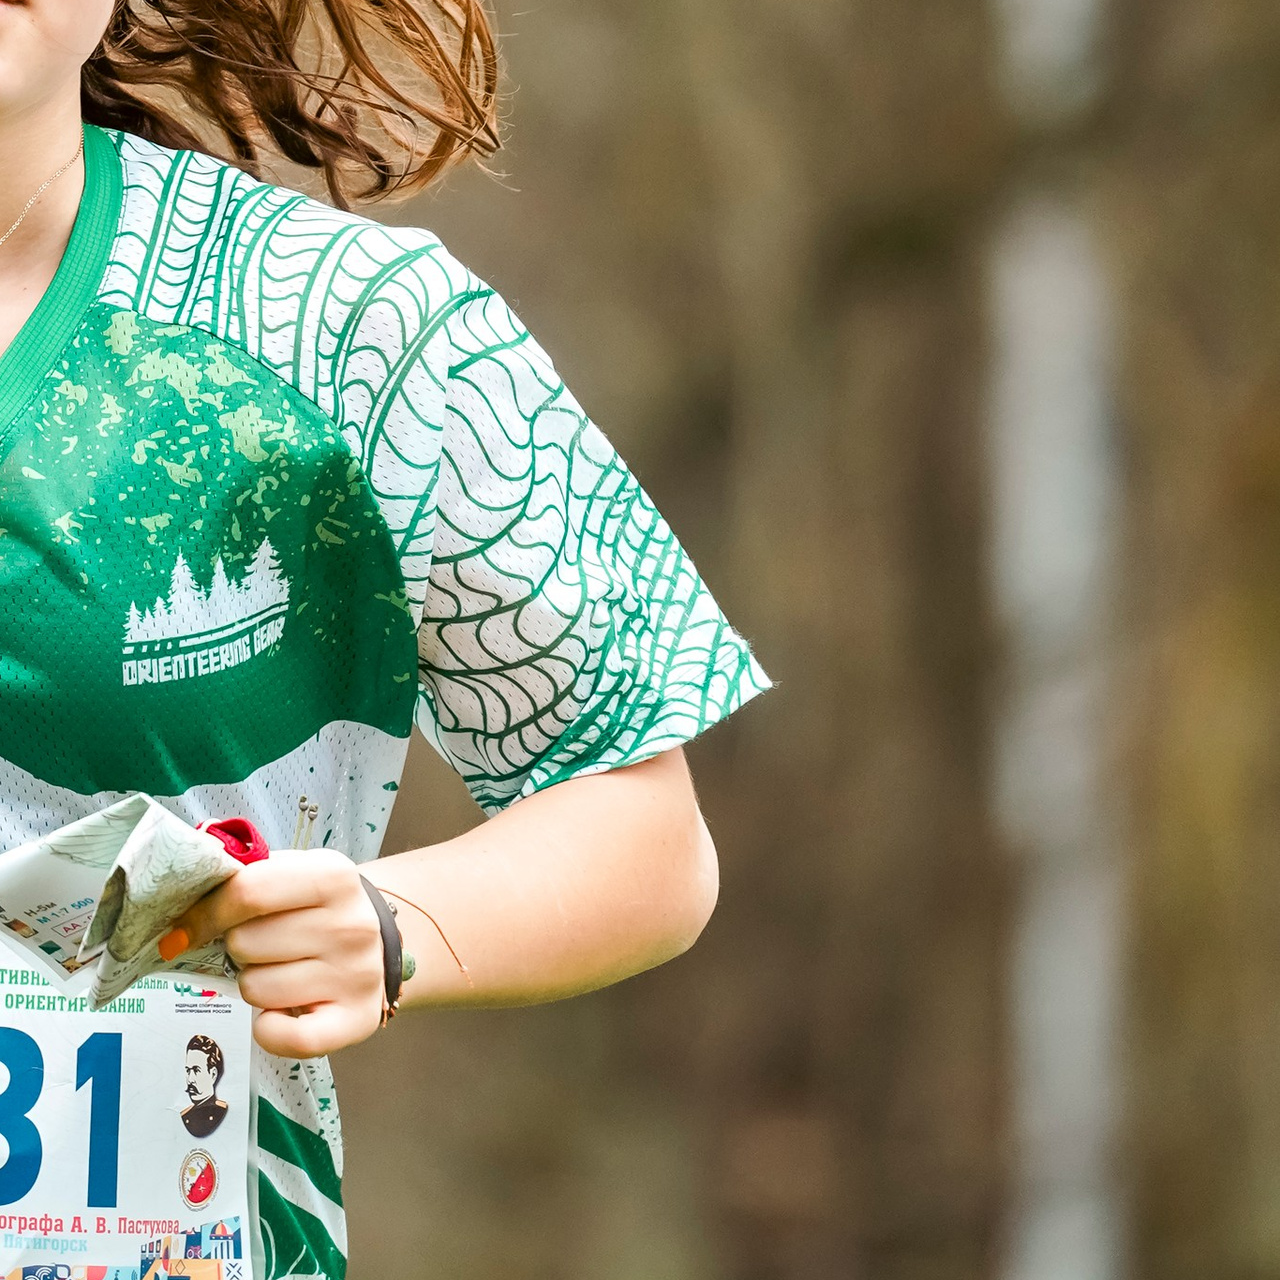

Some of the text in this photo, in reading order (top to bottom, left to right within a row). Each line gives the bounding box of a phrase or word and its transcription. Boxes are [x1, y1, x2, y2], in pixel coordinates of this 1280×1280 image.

[122, 615, 286, 687] ORIENTEERING GEAR
[5, 993, 145, 1014] ОРИЕНТИРАНИЮ
[70, 1216, 88, 1233] А.
[95, 1216, 111, 1234] В.
[118, 1217, 180, 1238] Пастухова
[3, 1233, 88, 1254] Пятигорск
